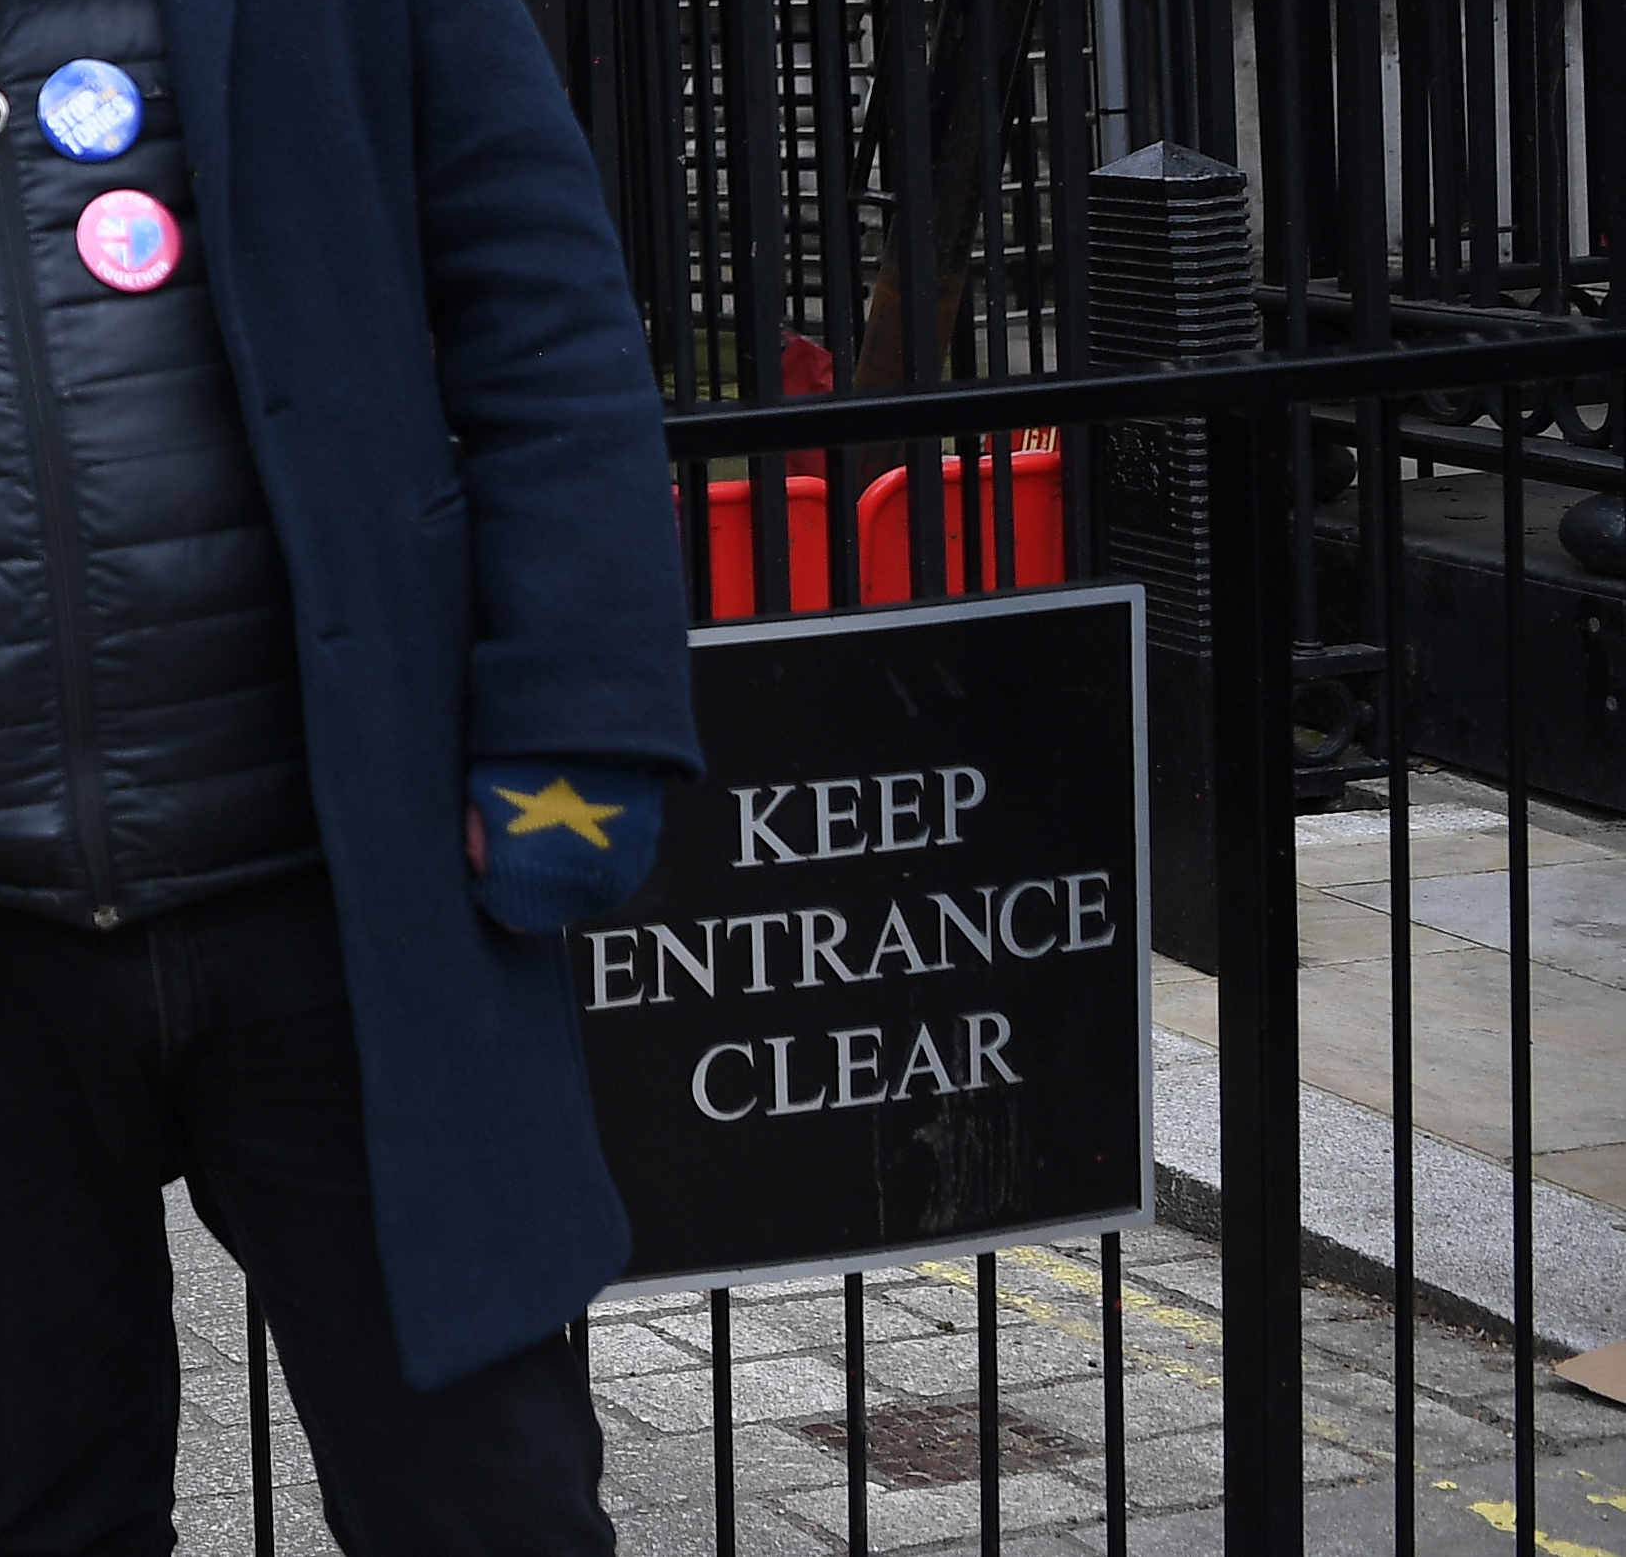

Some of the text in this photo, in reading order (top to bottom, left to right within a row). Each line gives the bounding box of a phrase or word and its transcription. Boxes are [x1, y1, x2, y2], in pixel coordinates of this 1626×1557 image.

[729, 766, 987, 869] KEEP
[583, 871, 1117, 1011] ENTRANCE
[692, 1011, 1022, 1122] CLEAR
